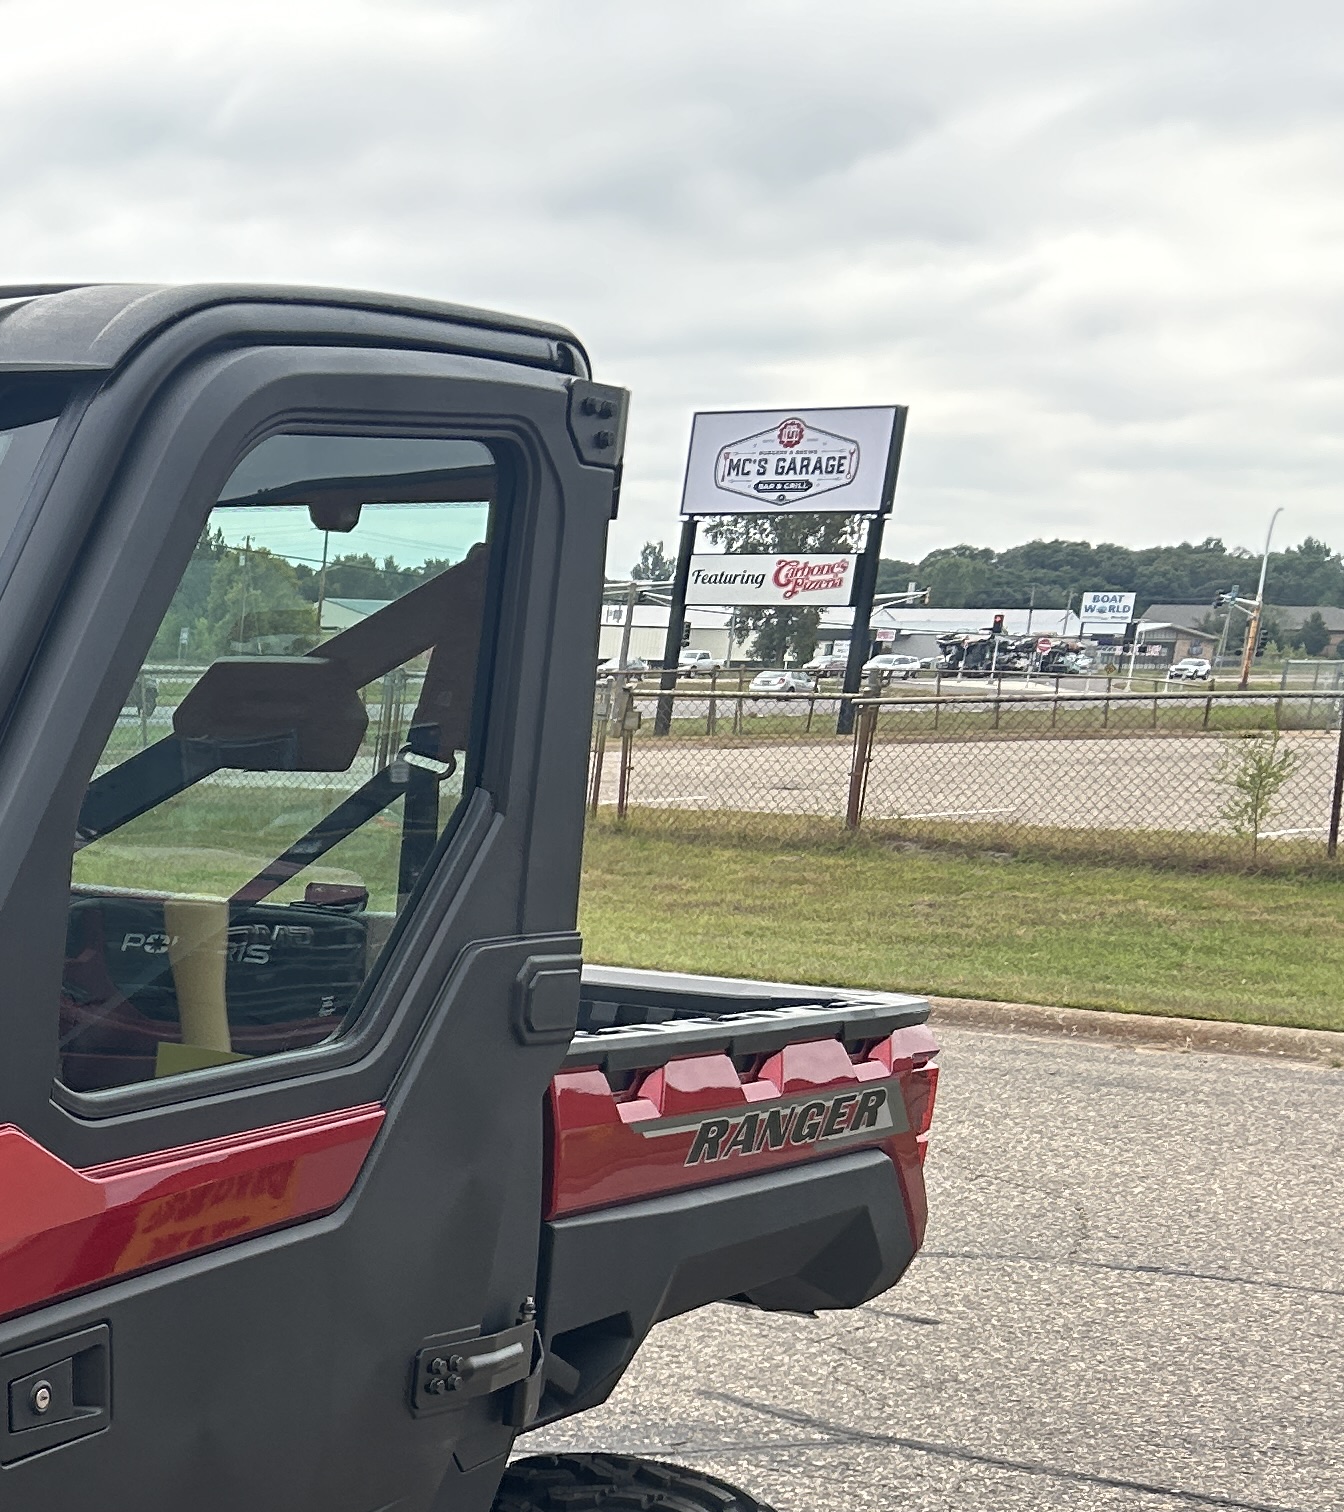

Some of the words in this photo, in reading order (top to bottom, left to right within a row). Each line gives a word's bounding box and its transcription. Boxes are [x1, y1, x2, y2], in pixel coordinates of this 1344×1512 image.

[726, 457, 769, 477] MC'S
[774, 455, 848, 476] GARAGE
[783, 482, 809, 490] GRILL
[692, 569, 767, 589] Featuring
[1092, 594, 1125, 604] BOAT
[684, 1086, 889, 1168] RANGER
